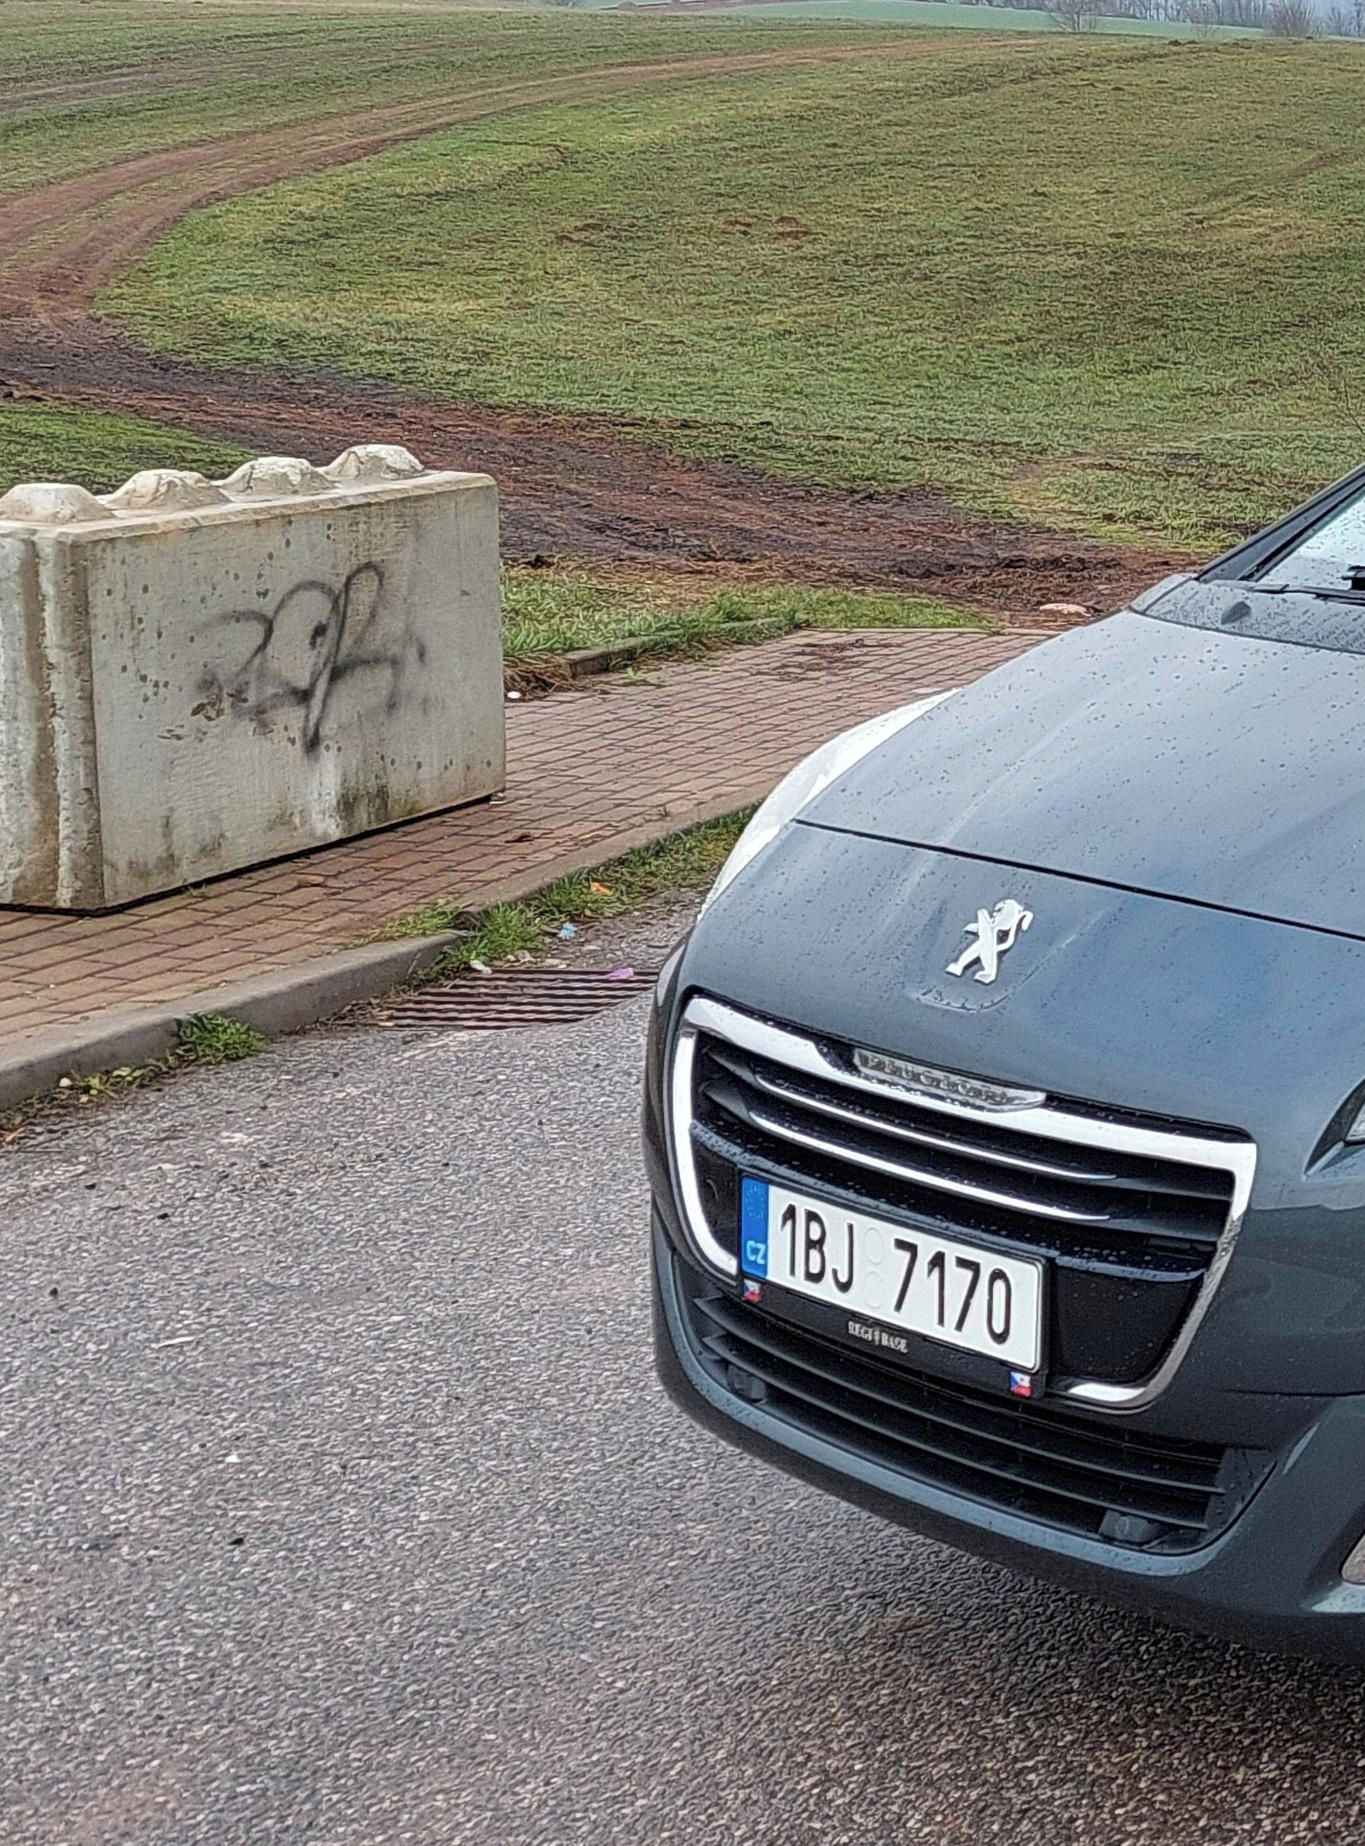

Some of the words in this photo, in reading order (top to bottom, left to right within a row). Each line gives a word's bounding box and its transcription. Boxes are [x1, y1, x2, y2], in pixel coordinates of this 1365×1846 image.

[746, 1240, 766, 1265] CZ
[780, 1203, 854, 1294] 1BJ
[893, 1237, 1012, 1345] 7170
